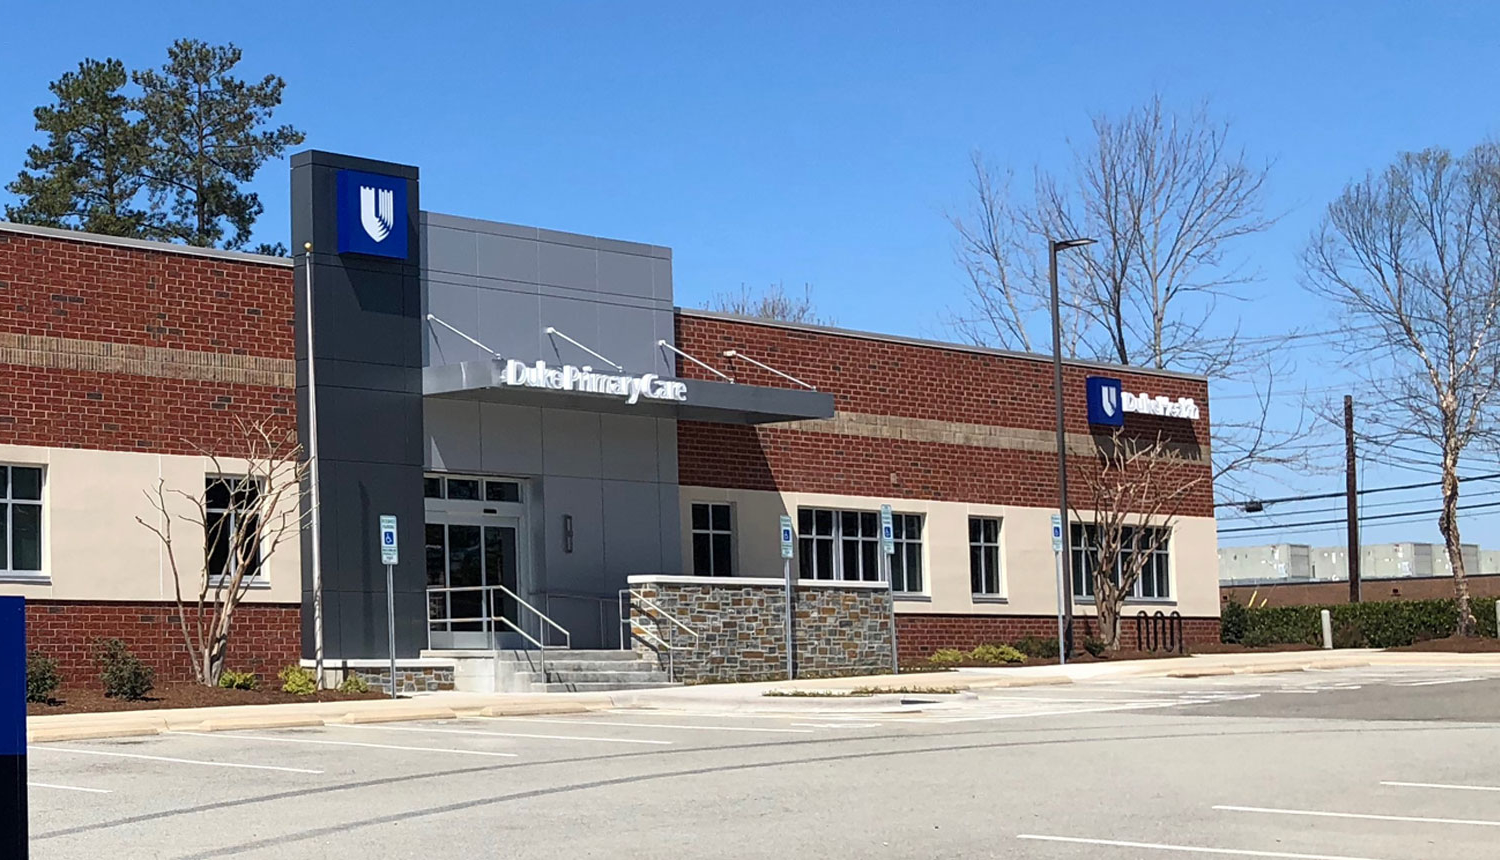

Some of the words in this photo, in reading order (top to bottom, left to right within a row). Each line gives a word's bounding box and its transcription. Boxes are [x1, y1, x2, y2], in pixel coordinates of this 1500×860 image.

[507, 359, 563, 389] Duke
[563, 365, 641, 404] Primary
[641, 373, 687, 400] Care
